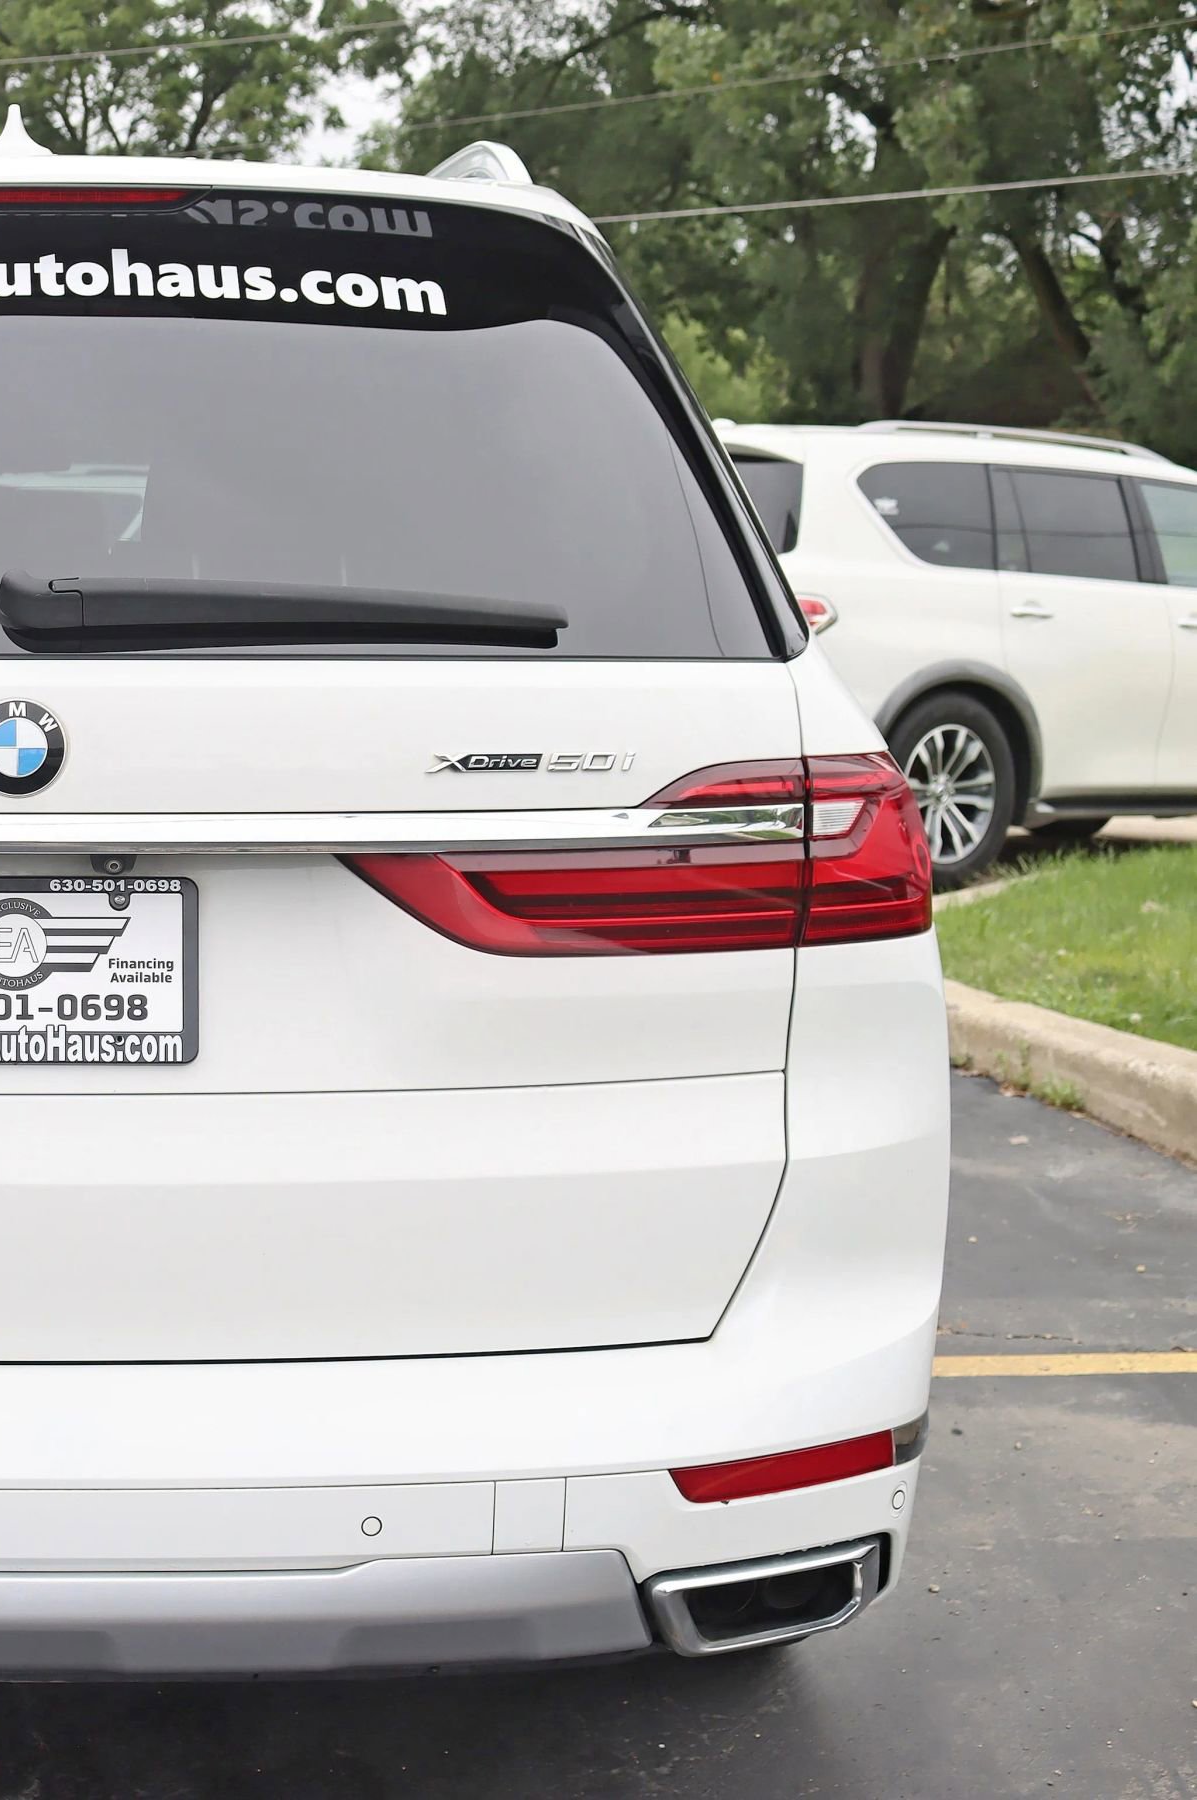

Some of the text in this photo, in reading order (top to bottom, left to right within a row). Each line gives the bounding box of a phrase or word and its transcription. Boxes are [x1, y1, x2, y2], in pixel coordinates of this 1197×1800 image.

[49, 879, 182, 892] 630-501-0698
[108, 958, 174, 973] Financing
[110, 972, 173, 984] Available
